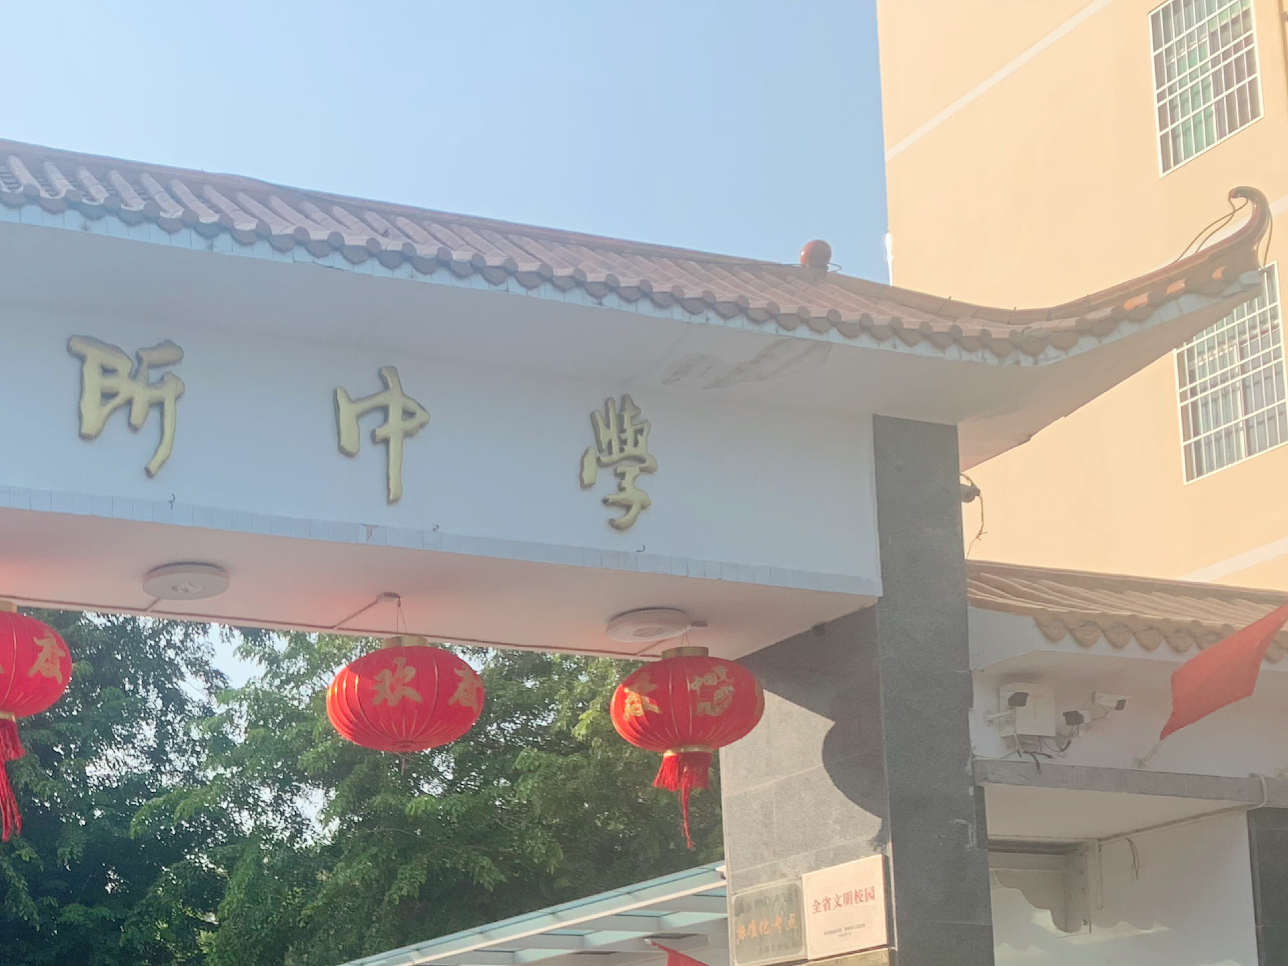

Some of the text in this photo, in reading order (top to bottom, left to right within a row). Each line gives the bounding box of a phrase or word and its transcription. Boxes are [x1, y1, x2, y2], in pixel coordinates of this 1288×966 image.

[812, 886, 875, 914] 全省文明校园
